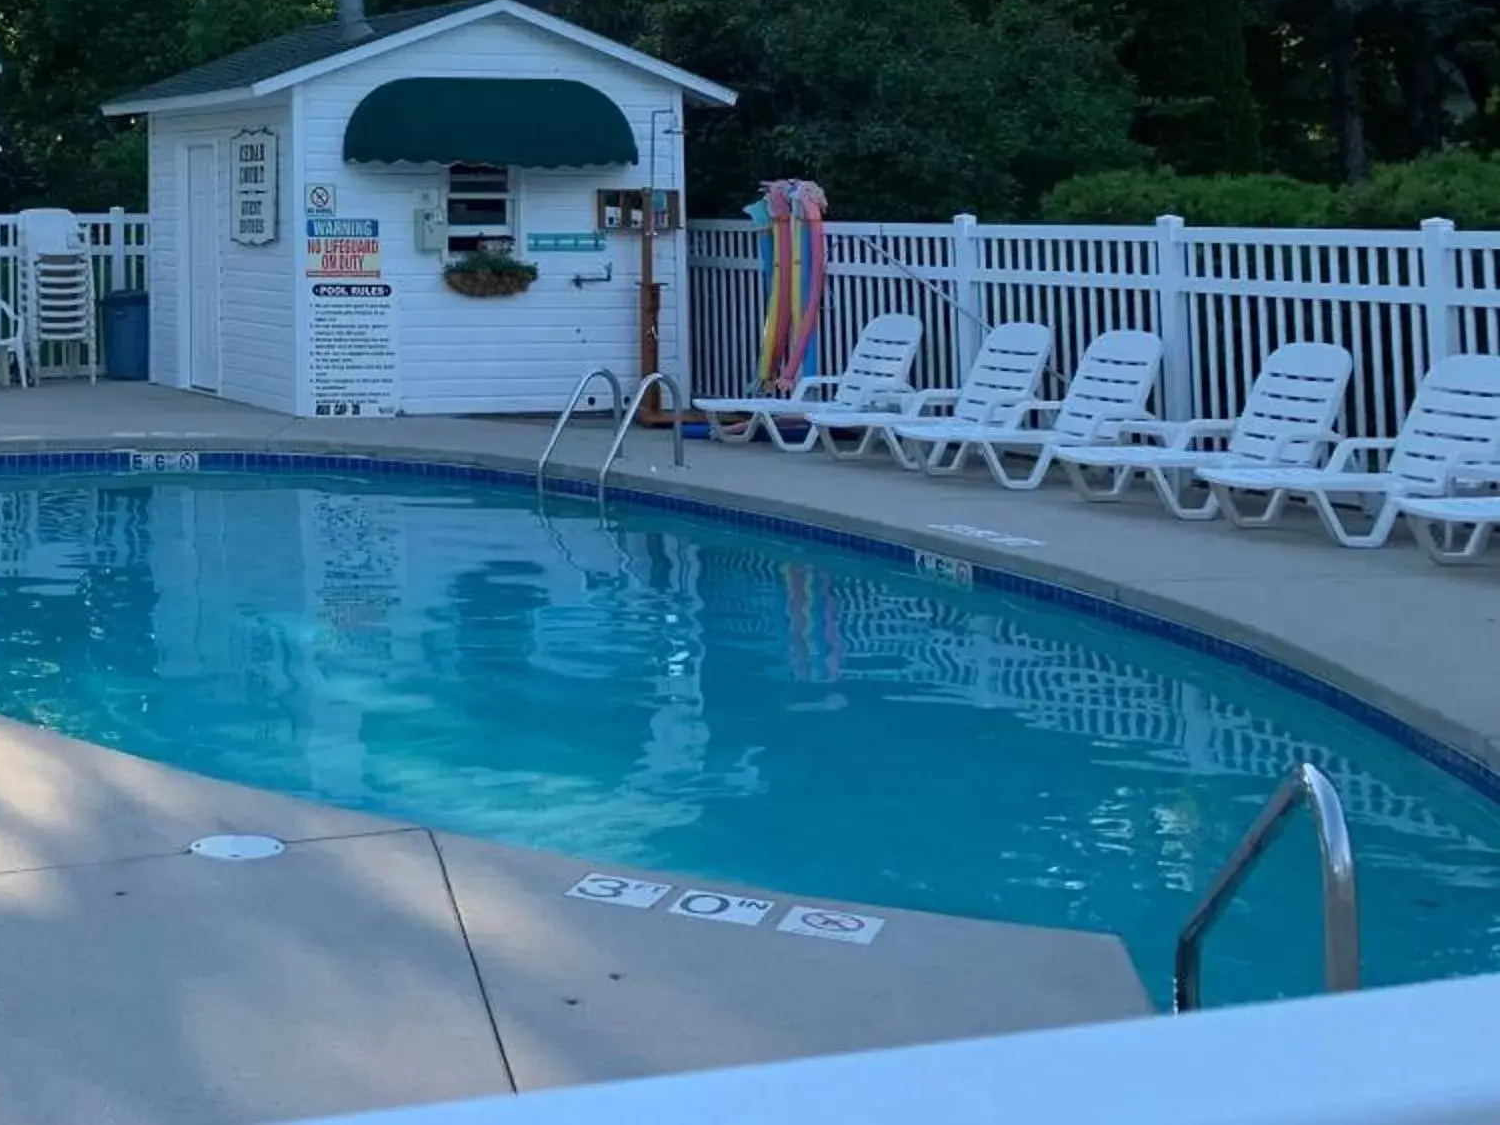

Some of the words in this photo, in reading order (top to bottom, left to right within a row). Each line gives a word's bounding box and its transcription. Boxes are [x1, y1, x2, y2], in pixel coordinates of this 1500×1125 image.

[314, 220, 374, 236] WARNING
[308, 239, 321, 254] NO
[325, 239, 379, 255] LIFEGUARD
[322, 255, 337, 270] ON
[340, 255, 365, 271] DUTY
[321, 286, 349, 295] POOL
[352, 286, 385, 296] RULES
[577, 877, 630, 899] 3
[634, 883, 669, 894] FT
[738, 898, 770, 911] IN
